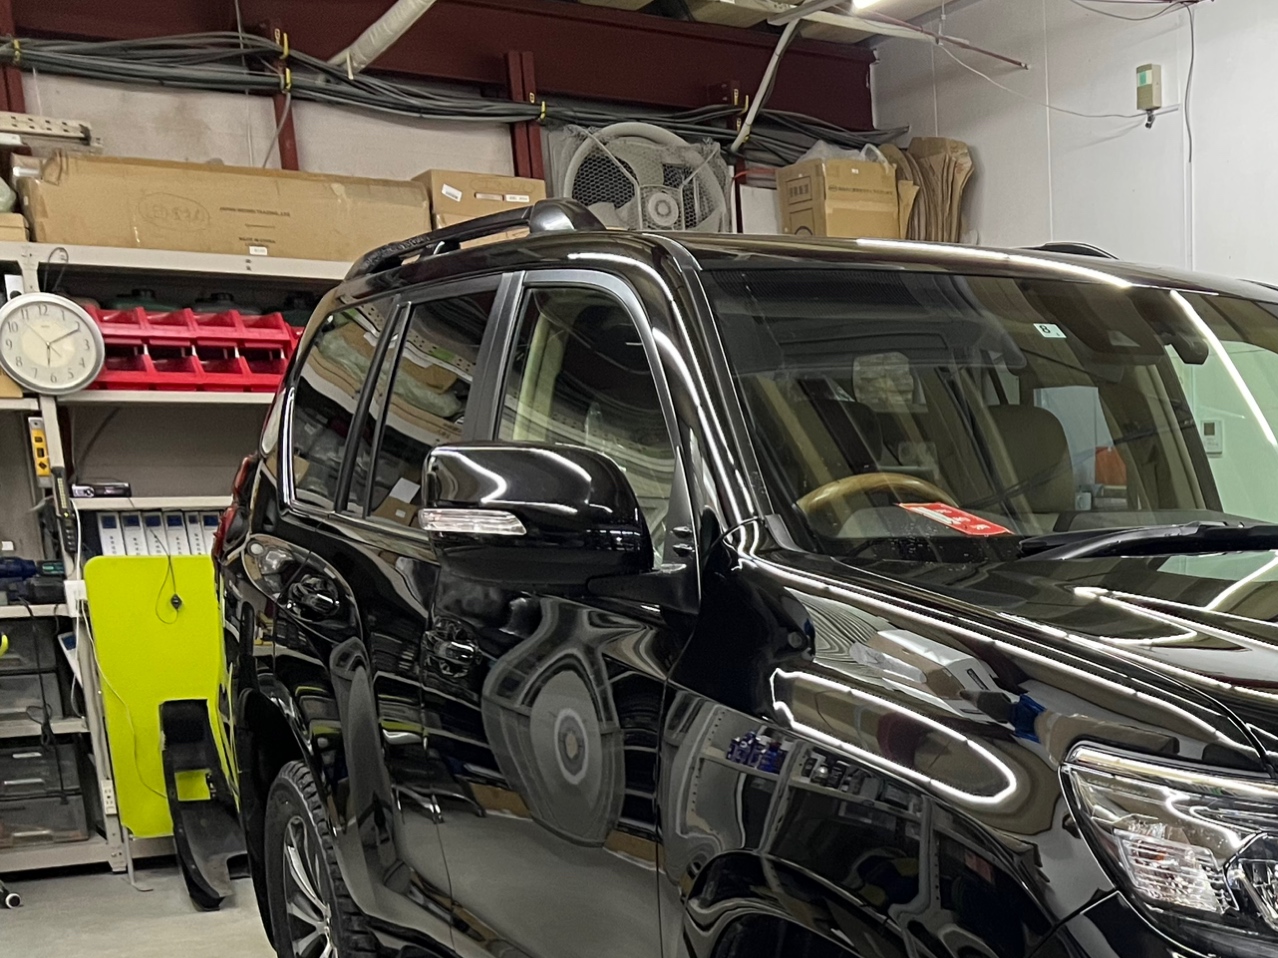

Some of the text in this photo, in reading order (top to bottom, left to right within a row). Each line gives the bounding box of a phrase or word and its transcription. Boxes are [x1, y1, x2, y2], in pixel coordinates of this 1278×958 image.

[38, 304, 48, 316] 12
[8, 321, 18, 333] 10
[5, 339, 13, 350] 9
[85, 339, 90, 351] 3
[15, 356, 23, 368] 8
[79, 357, 85, 368] 4
[31, 367, 38, 379] 7
[50, 373, 57, 384] 6
[68, 368, 74, 379] 5
